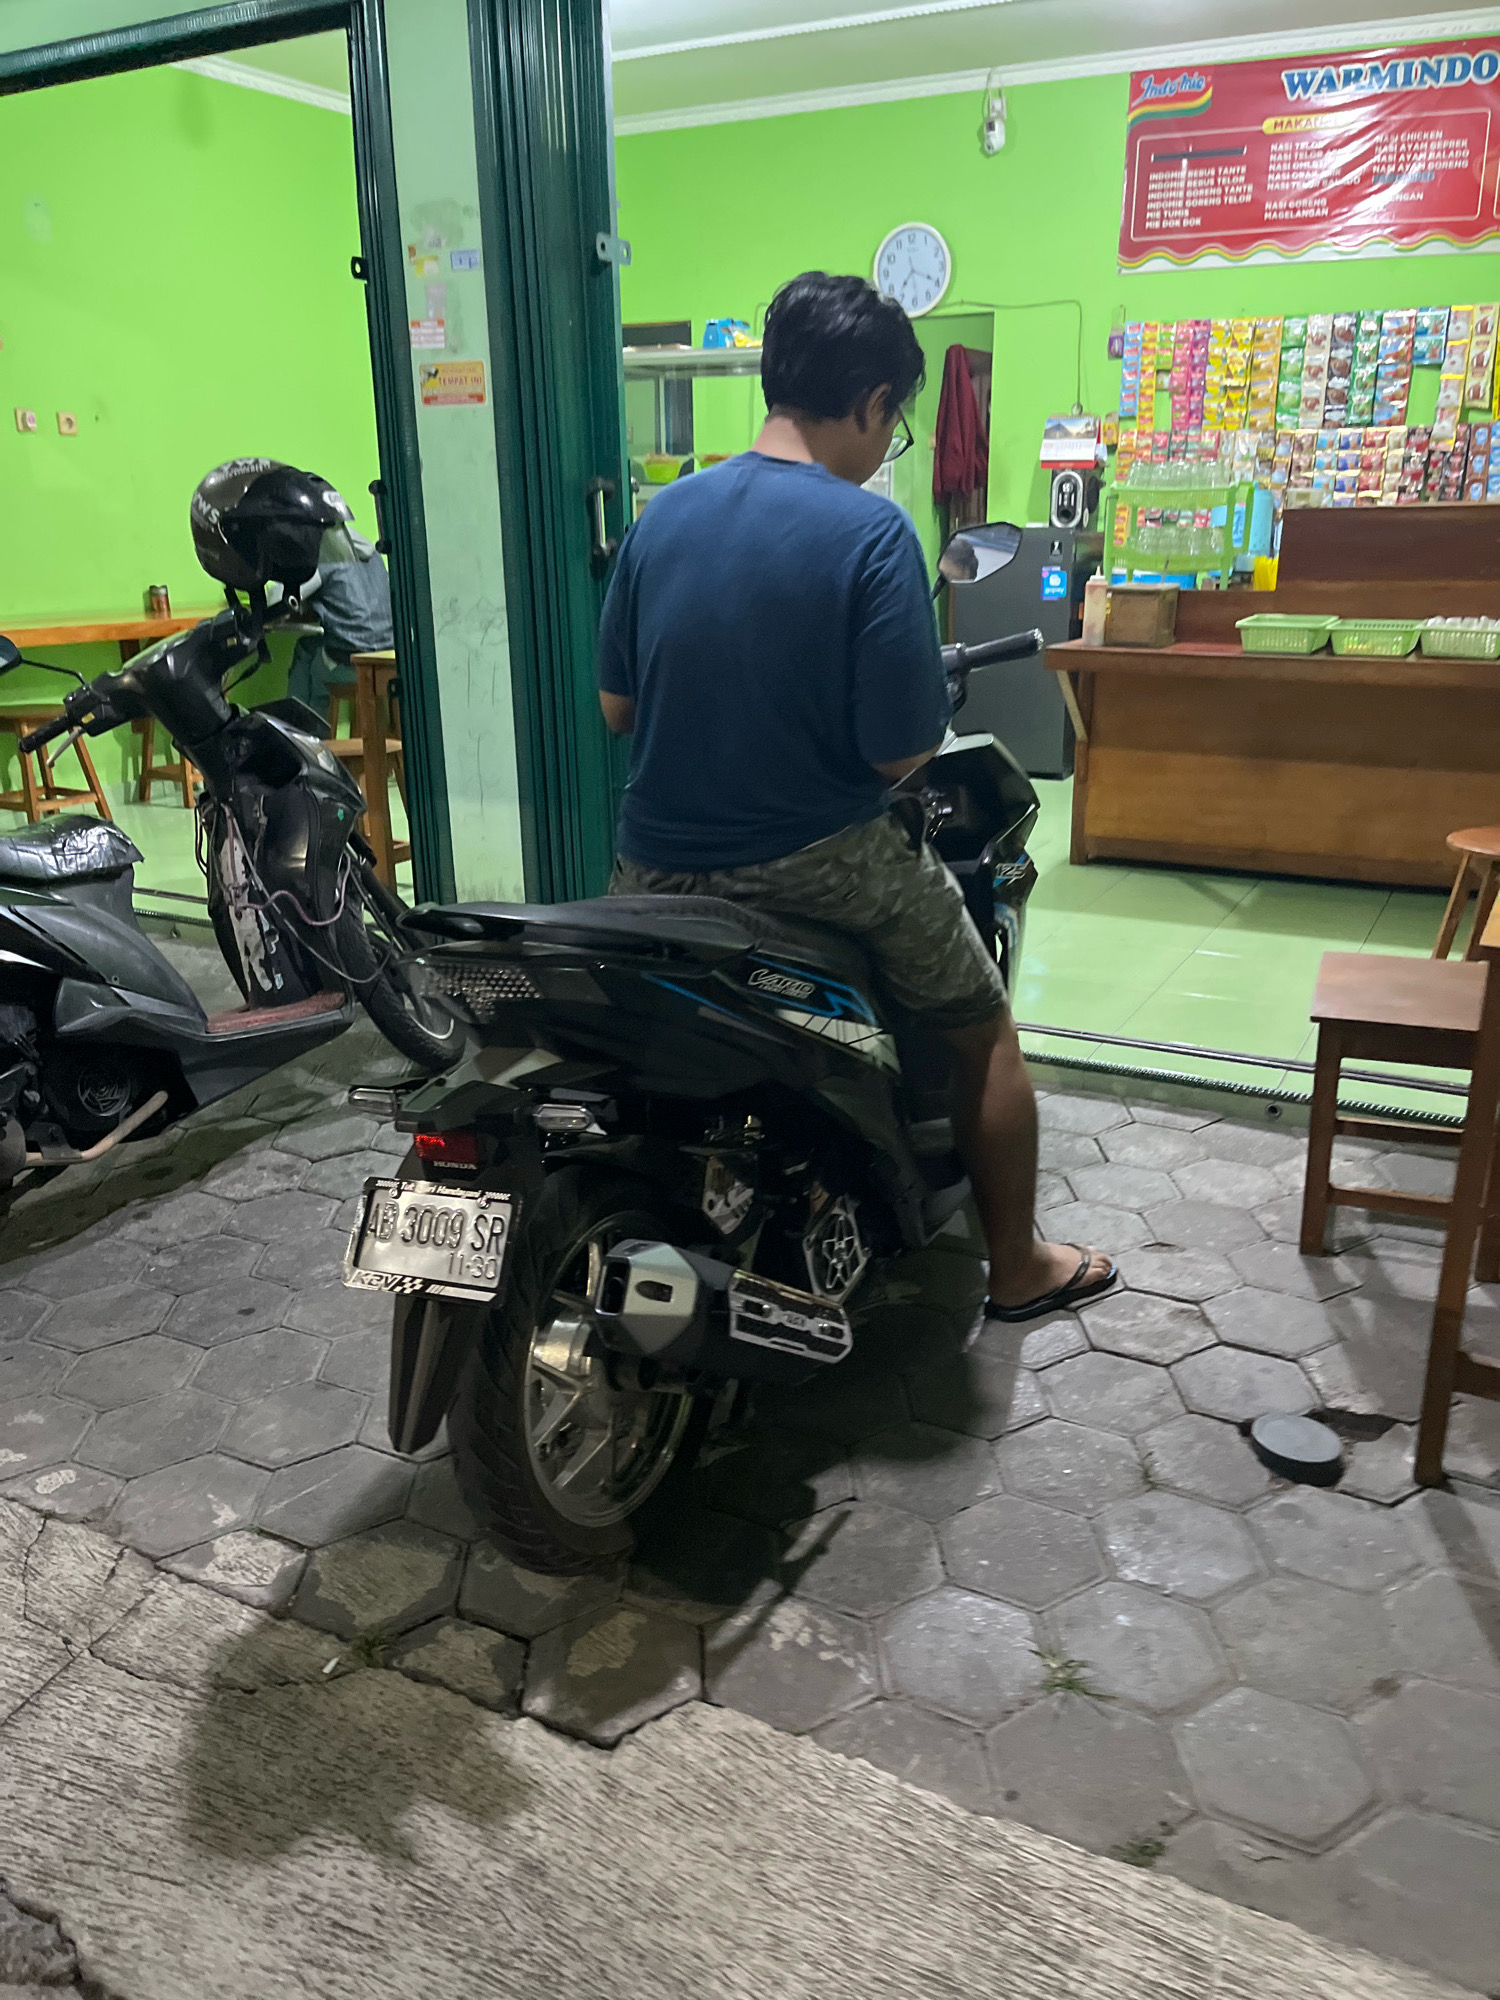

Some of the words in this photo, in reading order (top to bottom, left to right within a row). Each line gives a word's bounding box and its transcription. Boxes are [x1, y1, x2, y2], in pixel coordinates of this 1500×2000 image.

[1282, 50, 1499, 101] WARMINDO
[433, 1160, 477, 1170] HONDA
[366, 1201, 398, 1240] AB
[401, 1205, 465, 1249] 3009
[470, 1213, 505, 1255] SR
